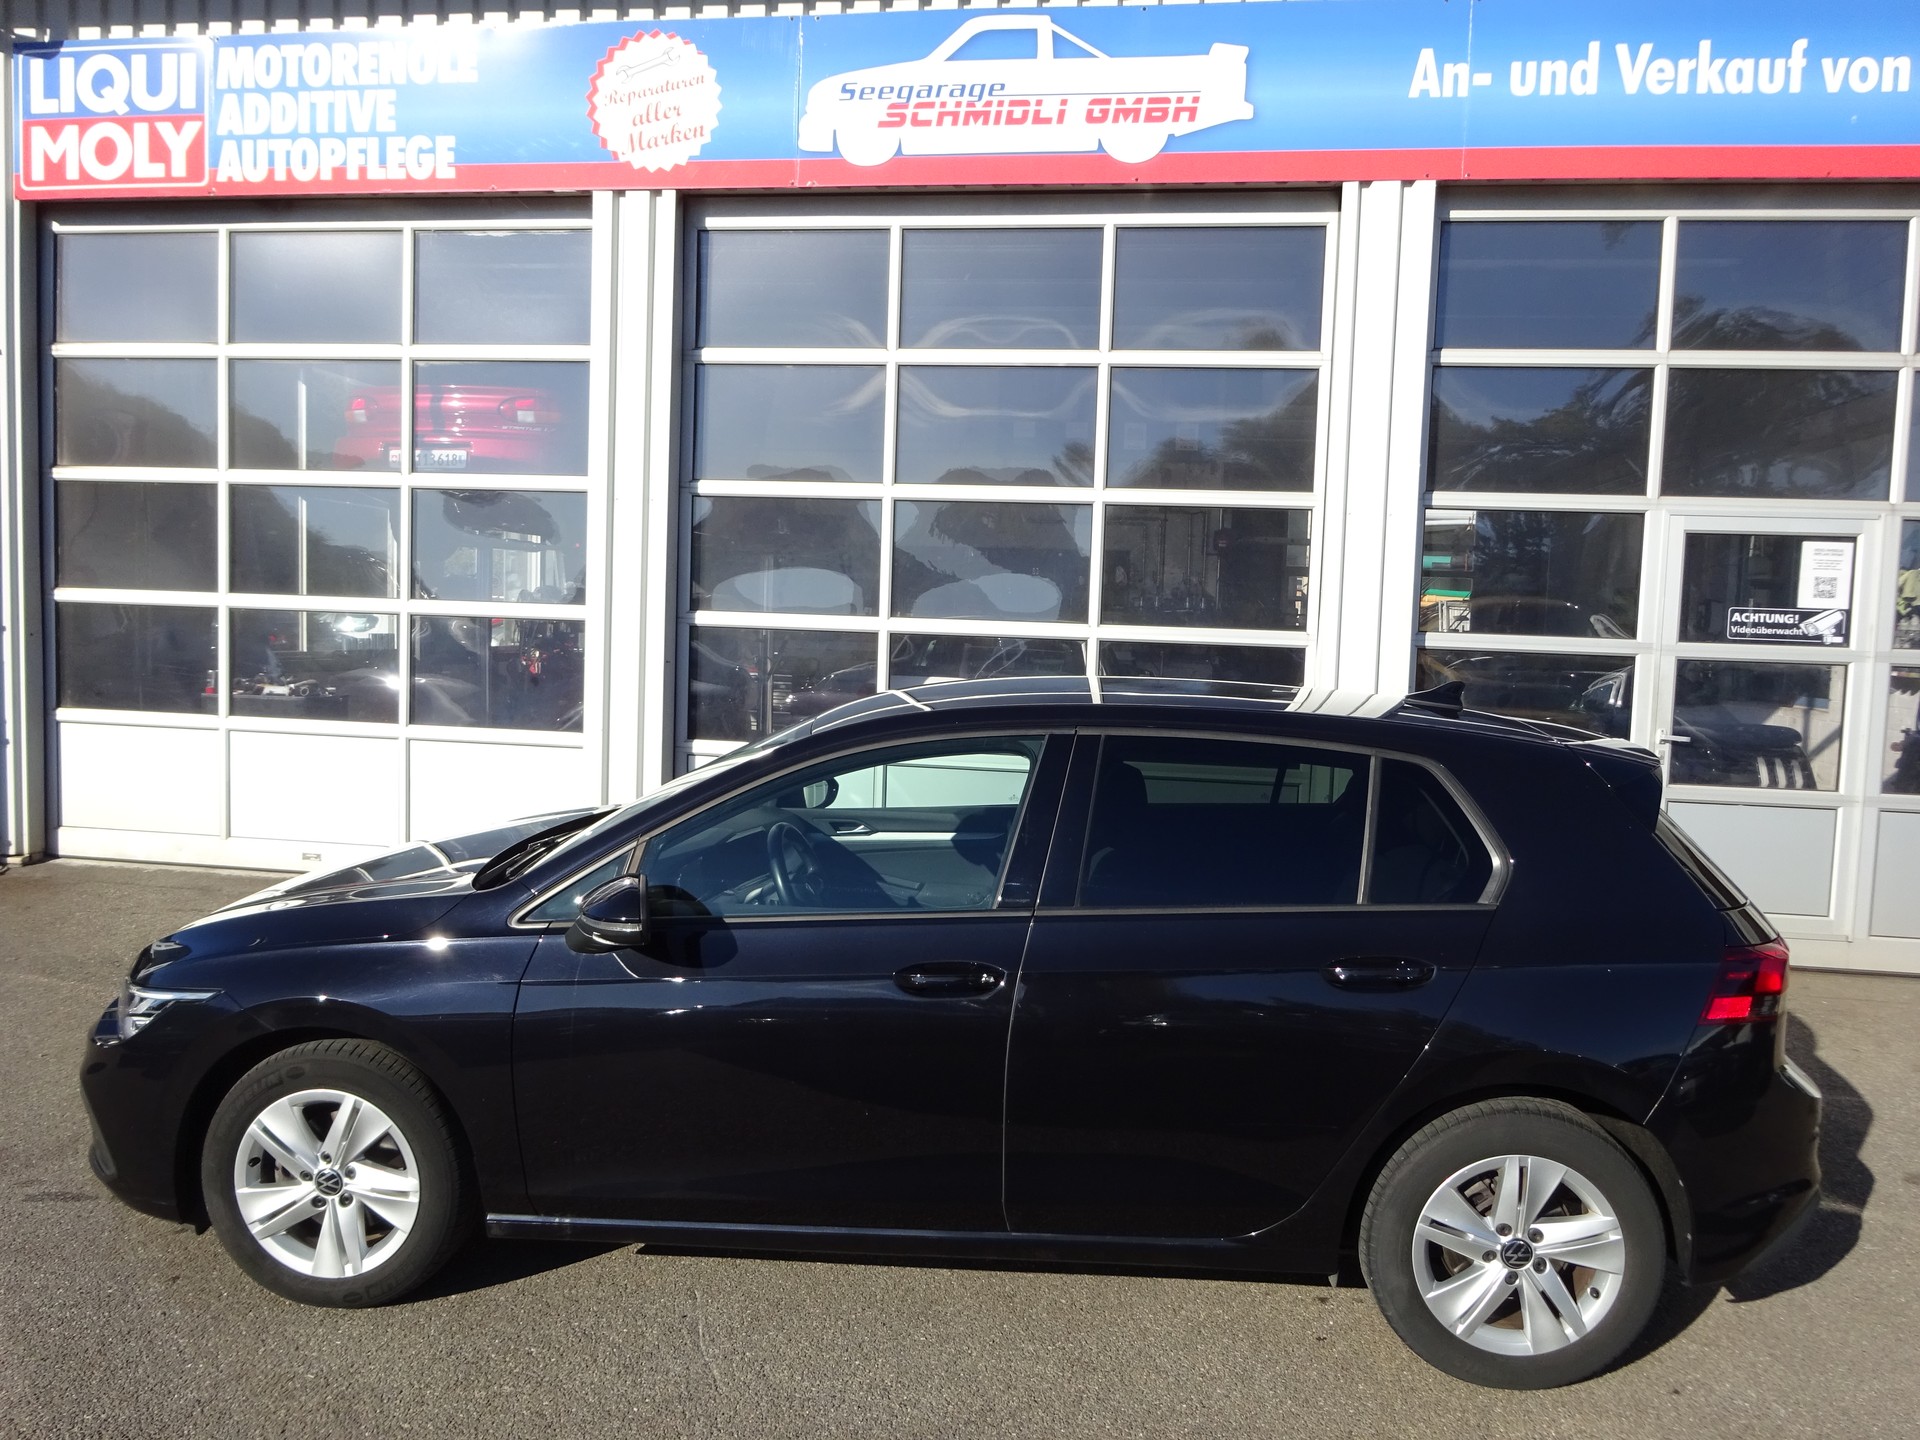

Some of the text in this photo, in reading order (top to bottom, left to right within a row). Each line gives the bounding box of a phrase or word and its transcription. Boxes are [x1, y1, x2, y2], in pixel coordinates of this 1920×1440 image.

[29, 53, 197, 115] LIQUI
[1408, 38, 1911, 98] An- und Verkauf von
[604, 75, 705, 107] Reparaturen
[839, 82, 1006, 104] Seegarage
[216, 89, 397, 135] ADDITIVE
[632, 101, 682, 127] aller
[877, 96, 1200, 128] SCHMIDLI GMBH
[30, 121, 203, 181] MOLY
[621, 122, 705, 156] Marken
[216, 135, 457, 182] AUTOPFLEGE
[1730, 625, 1803, 636] Videoüberwacht
[1731, 612, 1800, 624] ACHTUNG!
